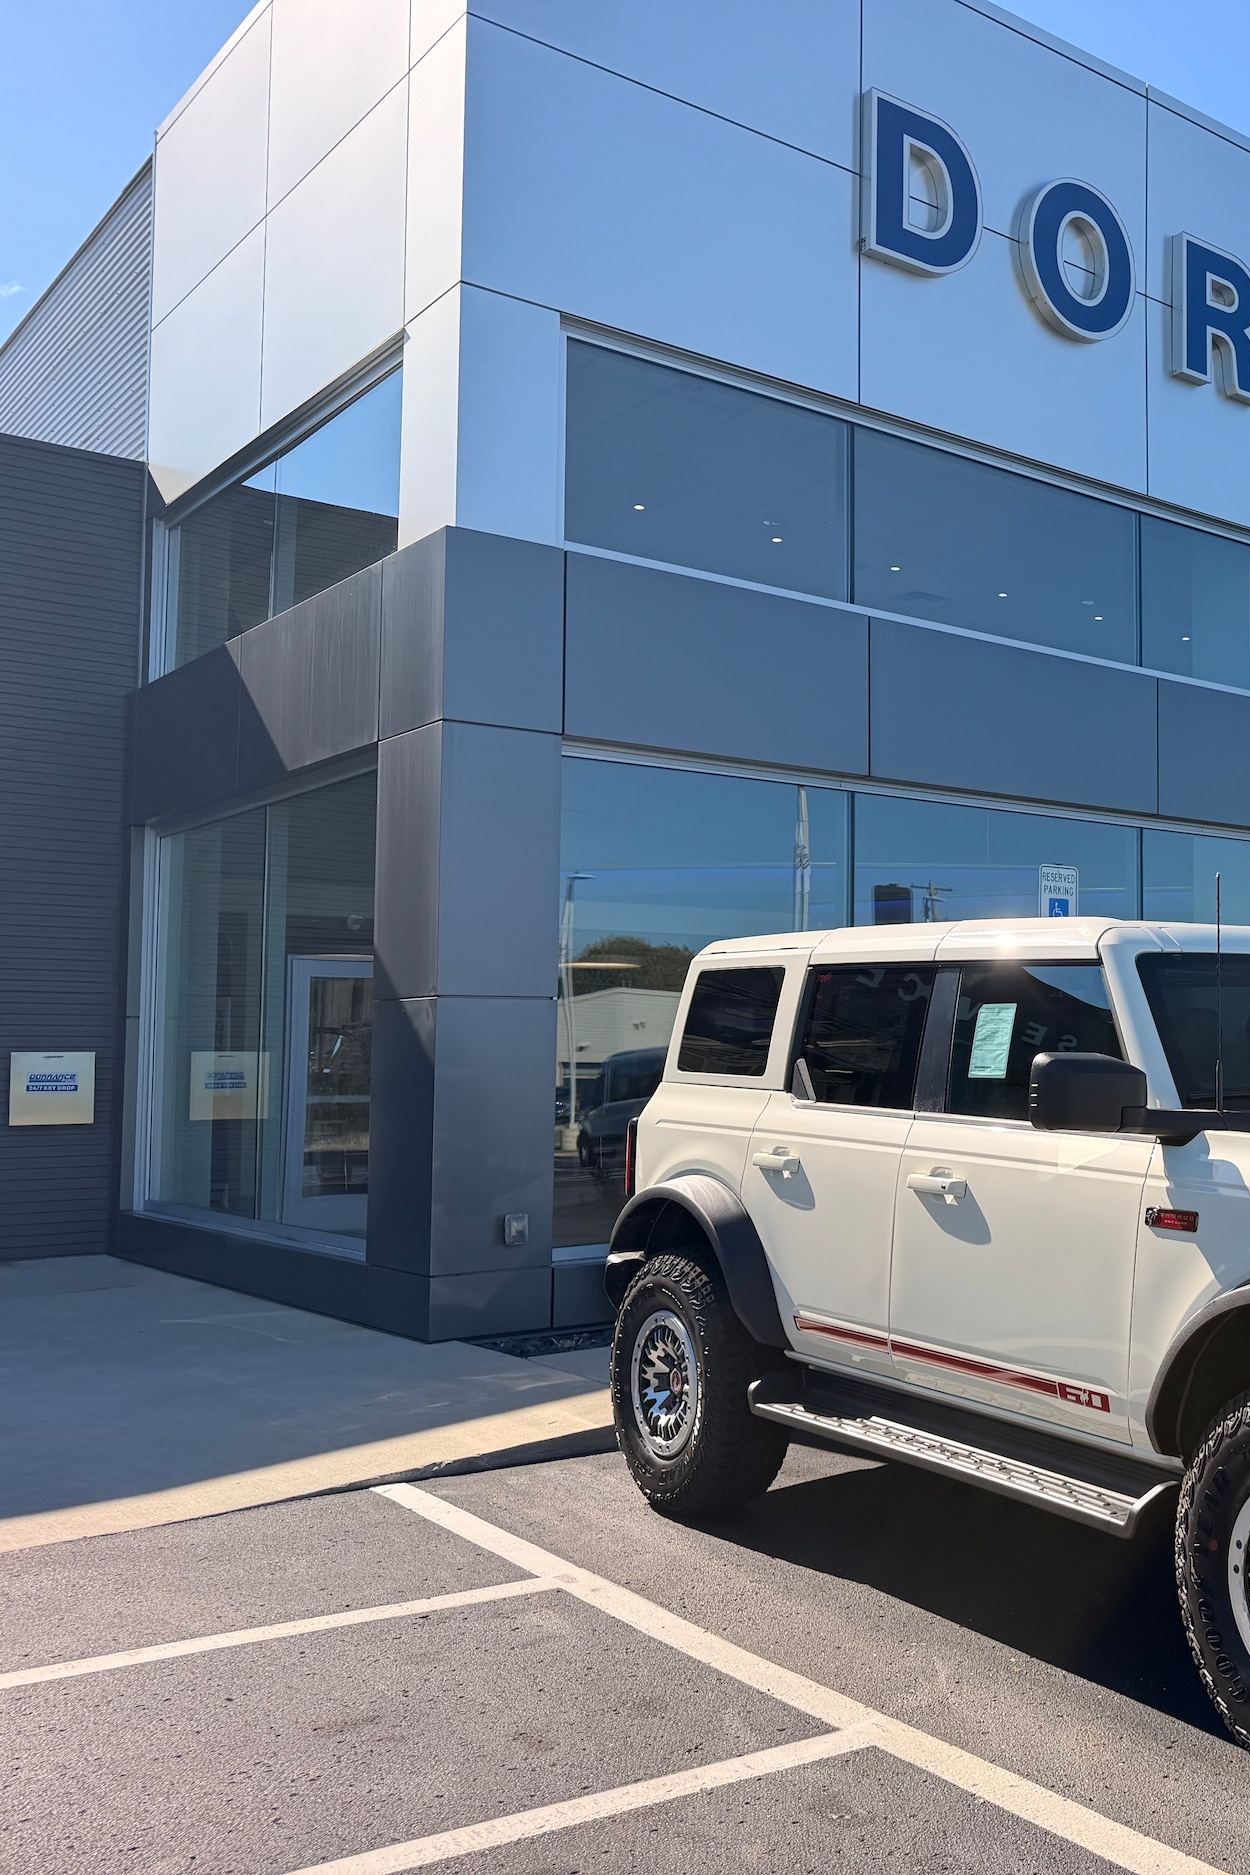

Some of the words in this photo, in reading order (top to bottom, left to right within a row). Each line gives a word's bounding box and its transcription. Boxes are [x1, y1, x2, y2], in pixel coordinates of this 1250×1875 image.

[1042, 871, 1076, 884] RESERVED
[1043, 884, 1074, 896] PARKING
[1057, 1382, 1111, 1414] 60
